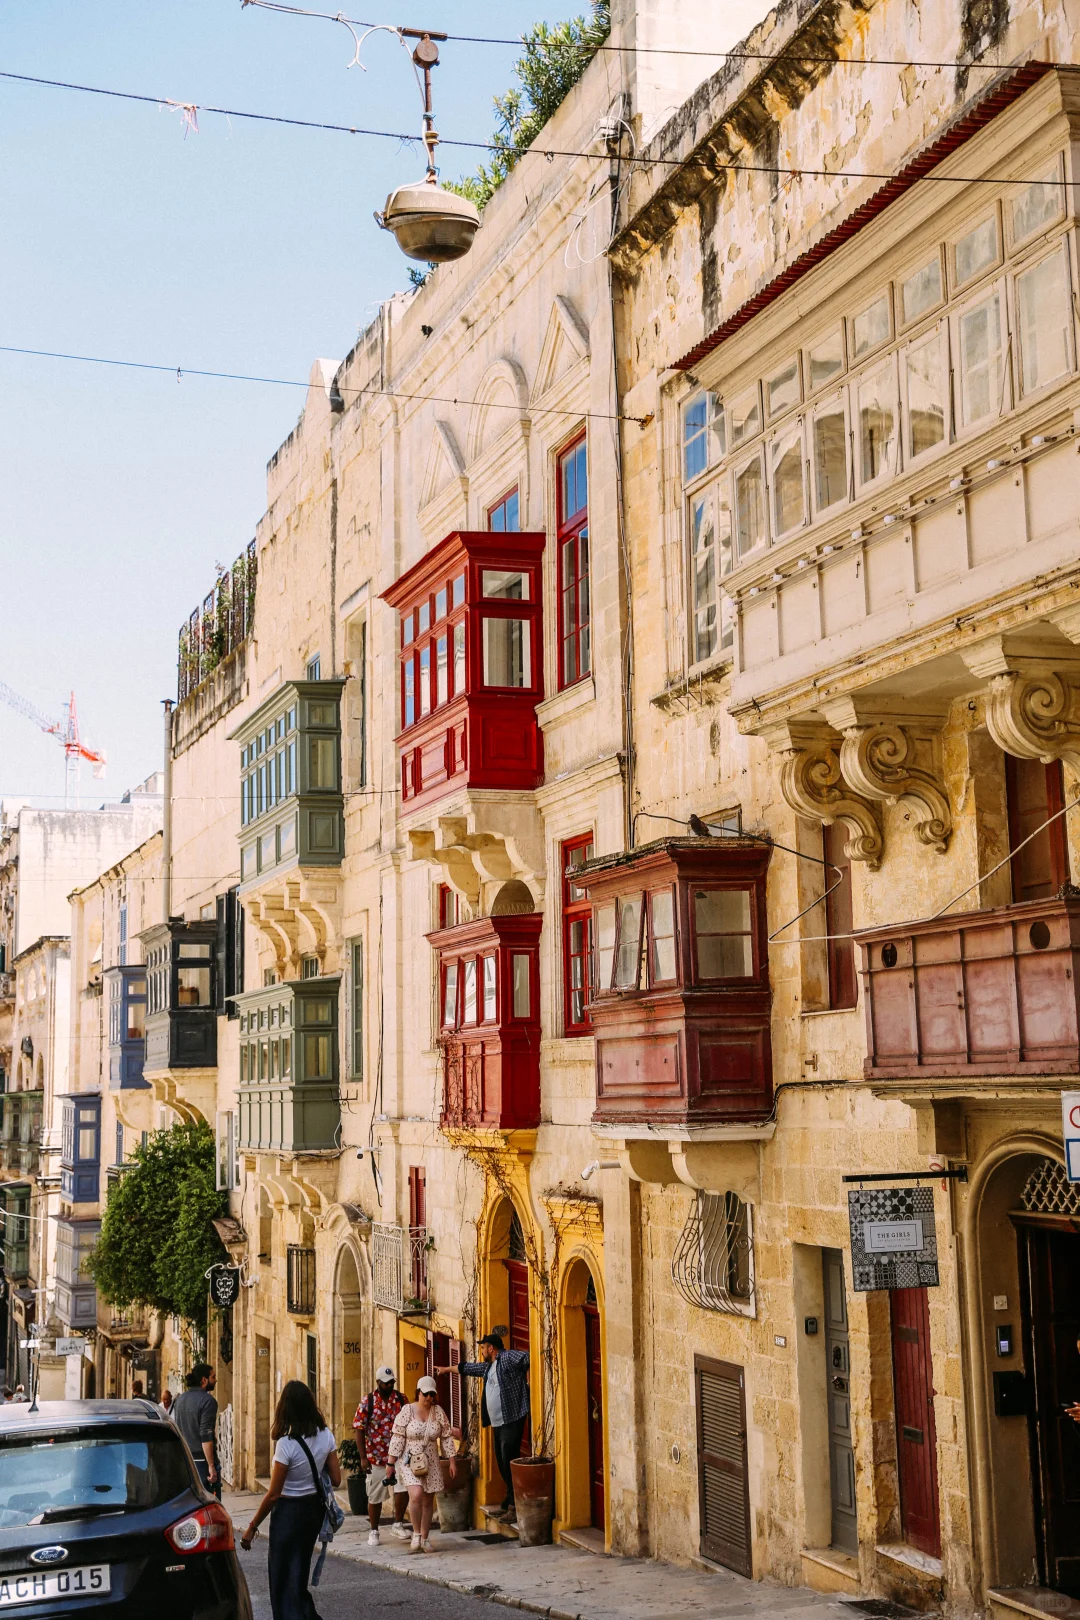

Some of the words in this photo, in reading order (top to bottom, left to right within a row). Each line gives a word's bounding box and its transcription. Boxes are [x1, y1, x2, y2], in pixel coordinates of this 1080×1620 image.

[343, 1342, 361, 1354] 316
[406, 1362, 420, 1371] 317
[39, 1549, 59, 1560] Ford
[0, 1574, 46, 1601] ACH
[57, 1568, 103, 1592] 015
